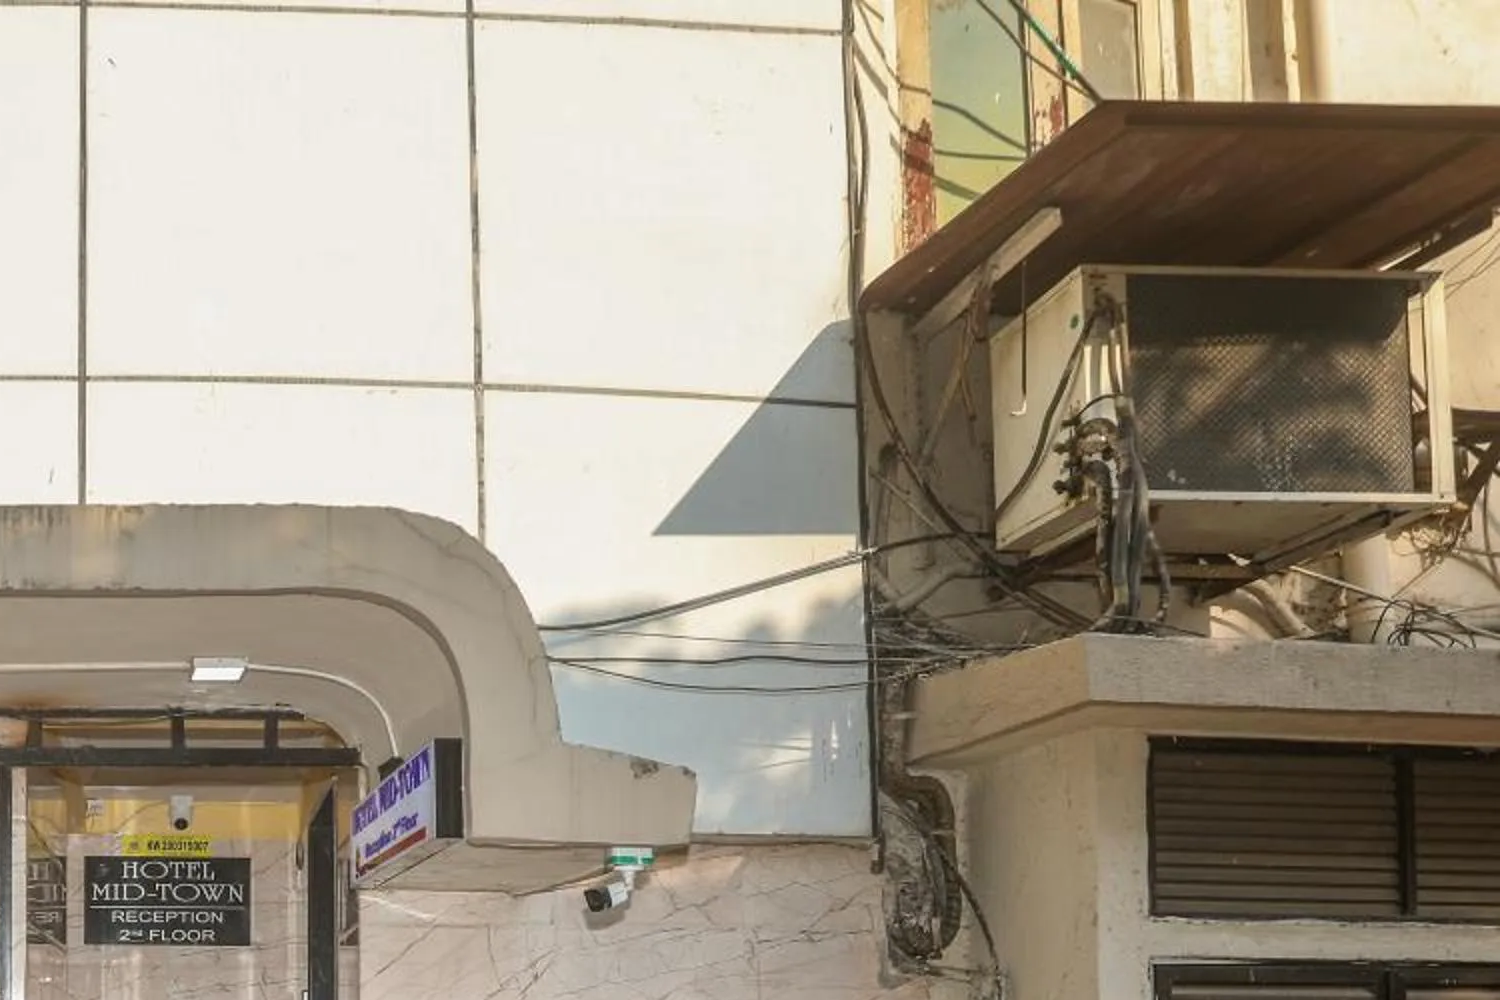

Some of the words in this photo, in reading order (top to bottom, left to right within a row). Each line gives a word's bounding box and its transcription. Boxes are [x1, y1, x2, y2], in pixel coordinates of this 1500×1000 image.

[121, 861, 215, 881] HOTEL
[91, 883, 244, 903] MID-TOWN
[111, 911, 224, 924] RECEPTION
[149, 929, 216, 942] FLOOR
